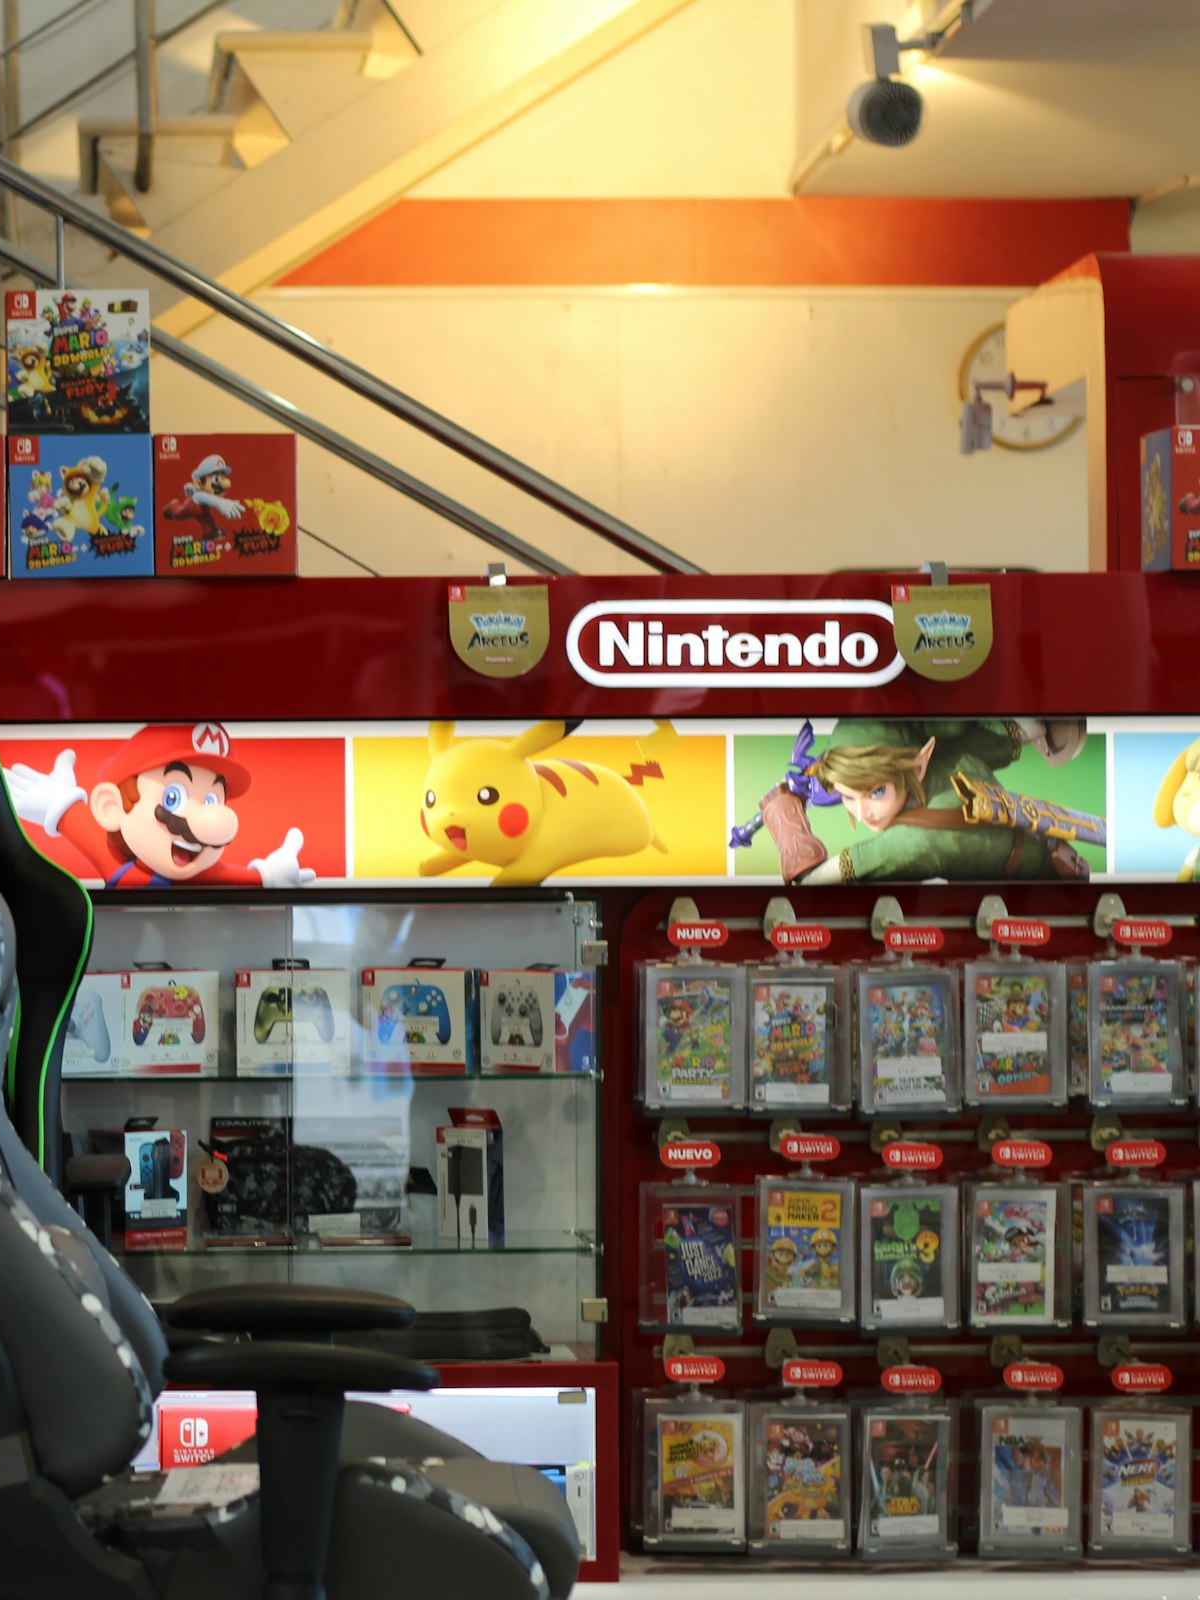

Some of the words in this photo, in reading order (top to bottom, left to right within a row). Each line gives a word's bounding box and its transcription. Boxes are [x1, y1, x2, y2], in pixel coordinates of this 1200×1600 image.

[53, 328, 109, 354] MARIO
[70, 347, 108, 365] WORLD
[173, 540, 216, 559] MARIO
[599, 620, 880, 668] Nintendo
[676, 928, 722, 940] NUEVO
[770, 1022, 815, 1040] MARIO
[671, 1067, 714, 1081] PARTY
[668, 1149, 712, 1160] NUEVO
[821, 1199, 836, 1222] 2
[681, 1242, 704, 1260] JUST
[916, 1231, 939, 1263] 3
[999, 1436, 1025, 1446] NBA
